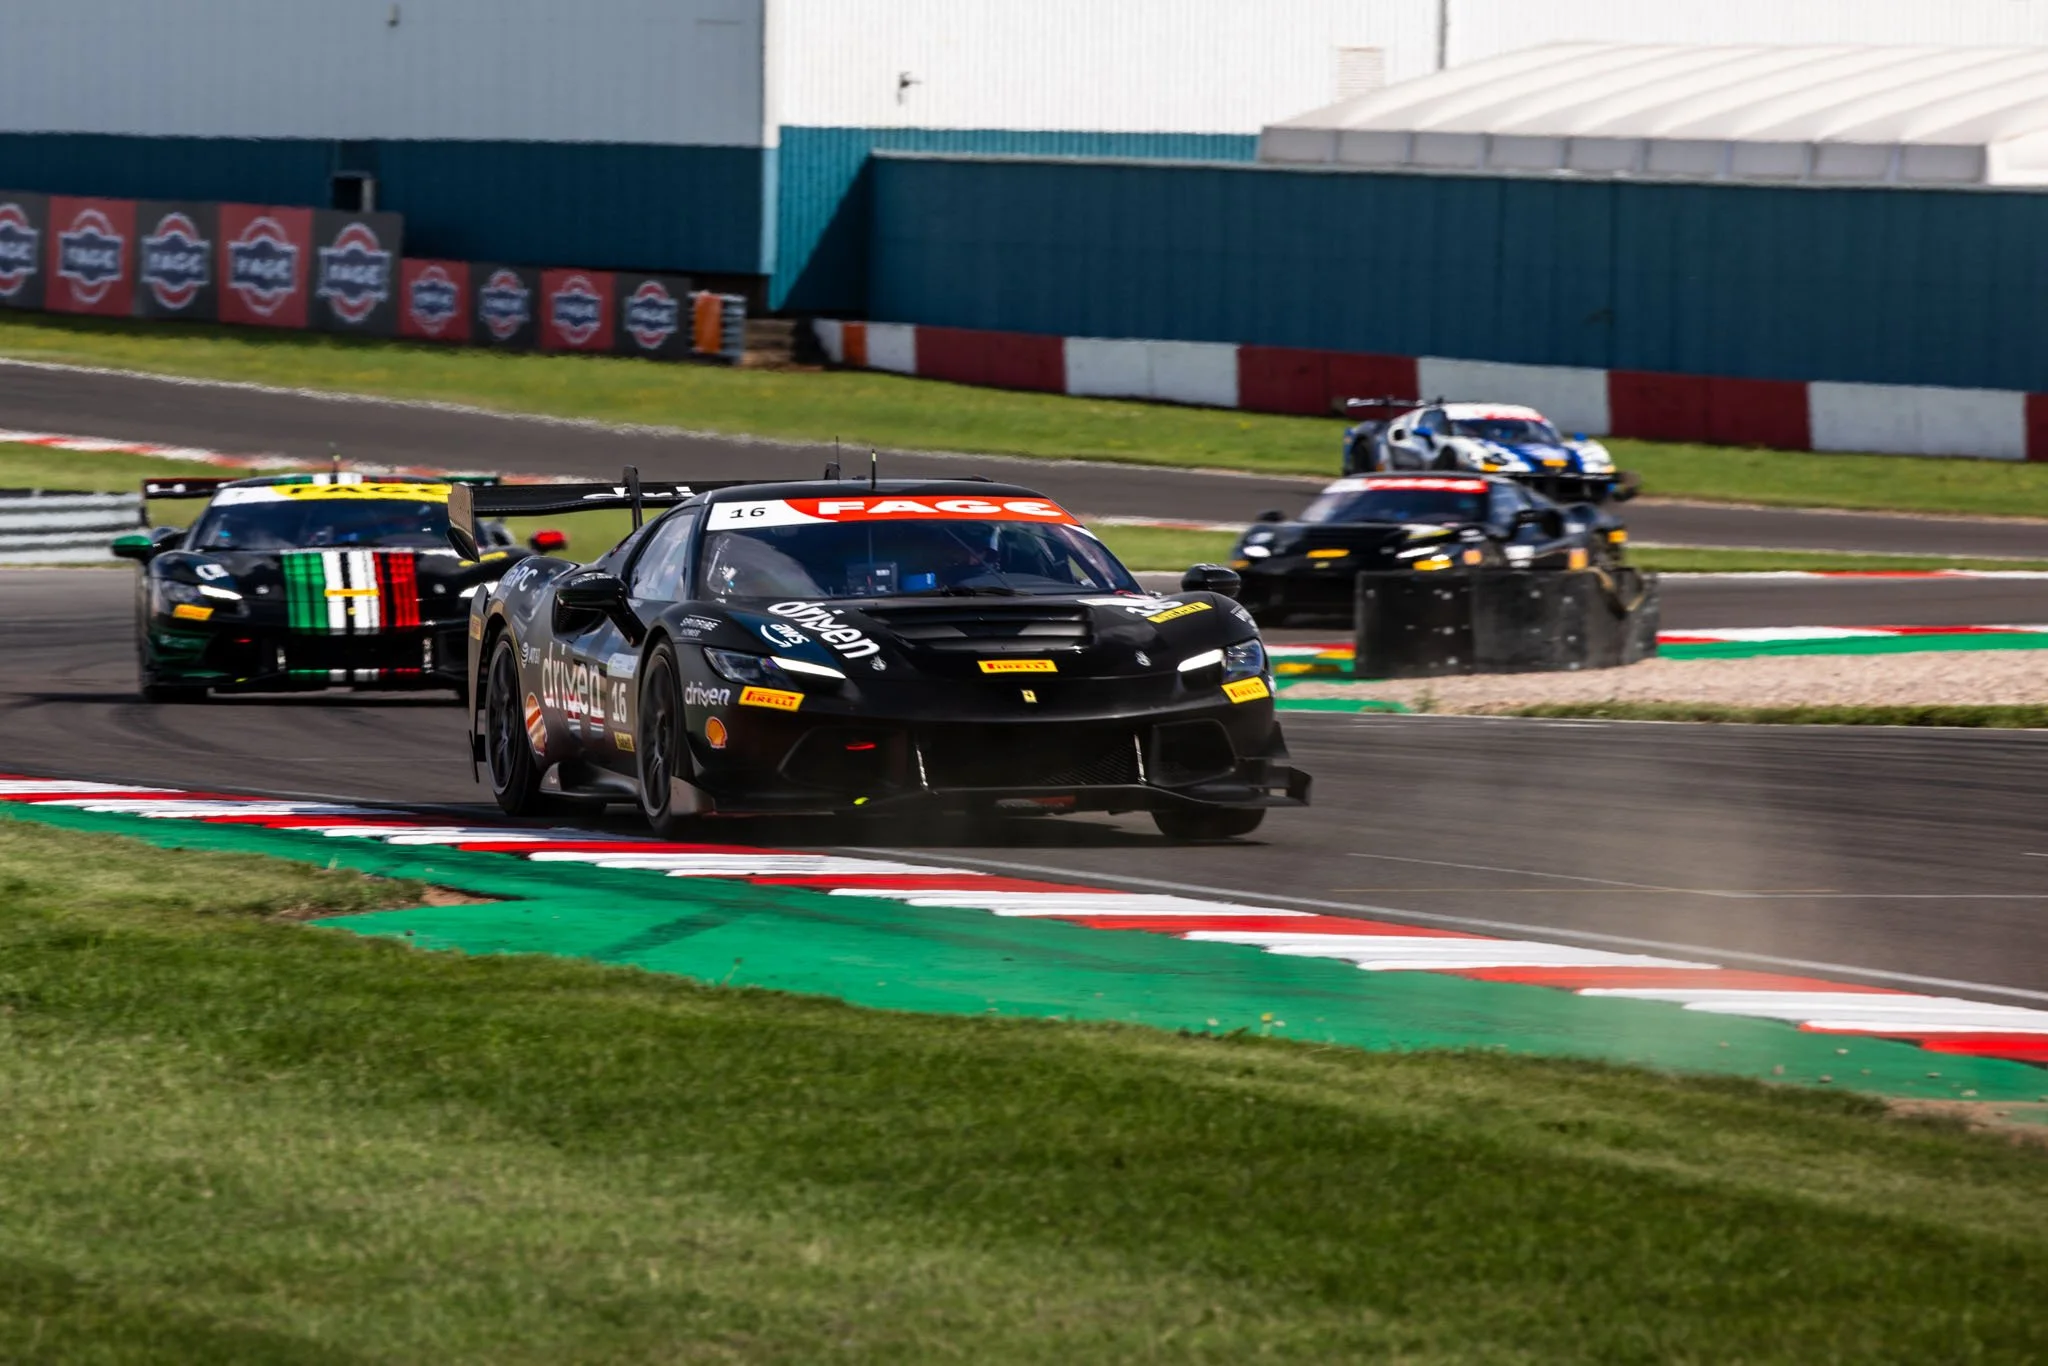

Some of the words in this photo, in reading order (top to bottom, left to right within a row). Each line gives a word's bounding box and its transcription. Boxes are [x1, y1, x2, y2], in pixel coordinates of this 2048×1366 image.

[729, 506, 767, 520] 16
[767, 601, 881, 659] driven
[769, 623, 811, 645] aws
[542, 641, 606, 719] driven
[611, 680, 627, 724] 16
[684, 682, 731, 708] driven
[745, 690, 796, 707] PIRELLI
